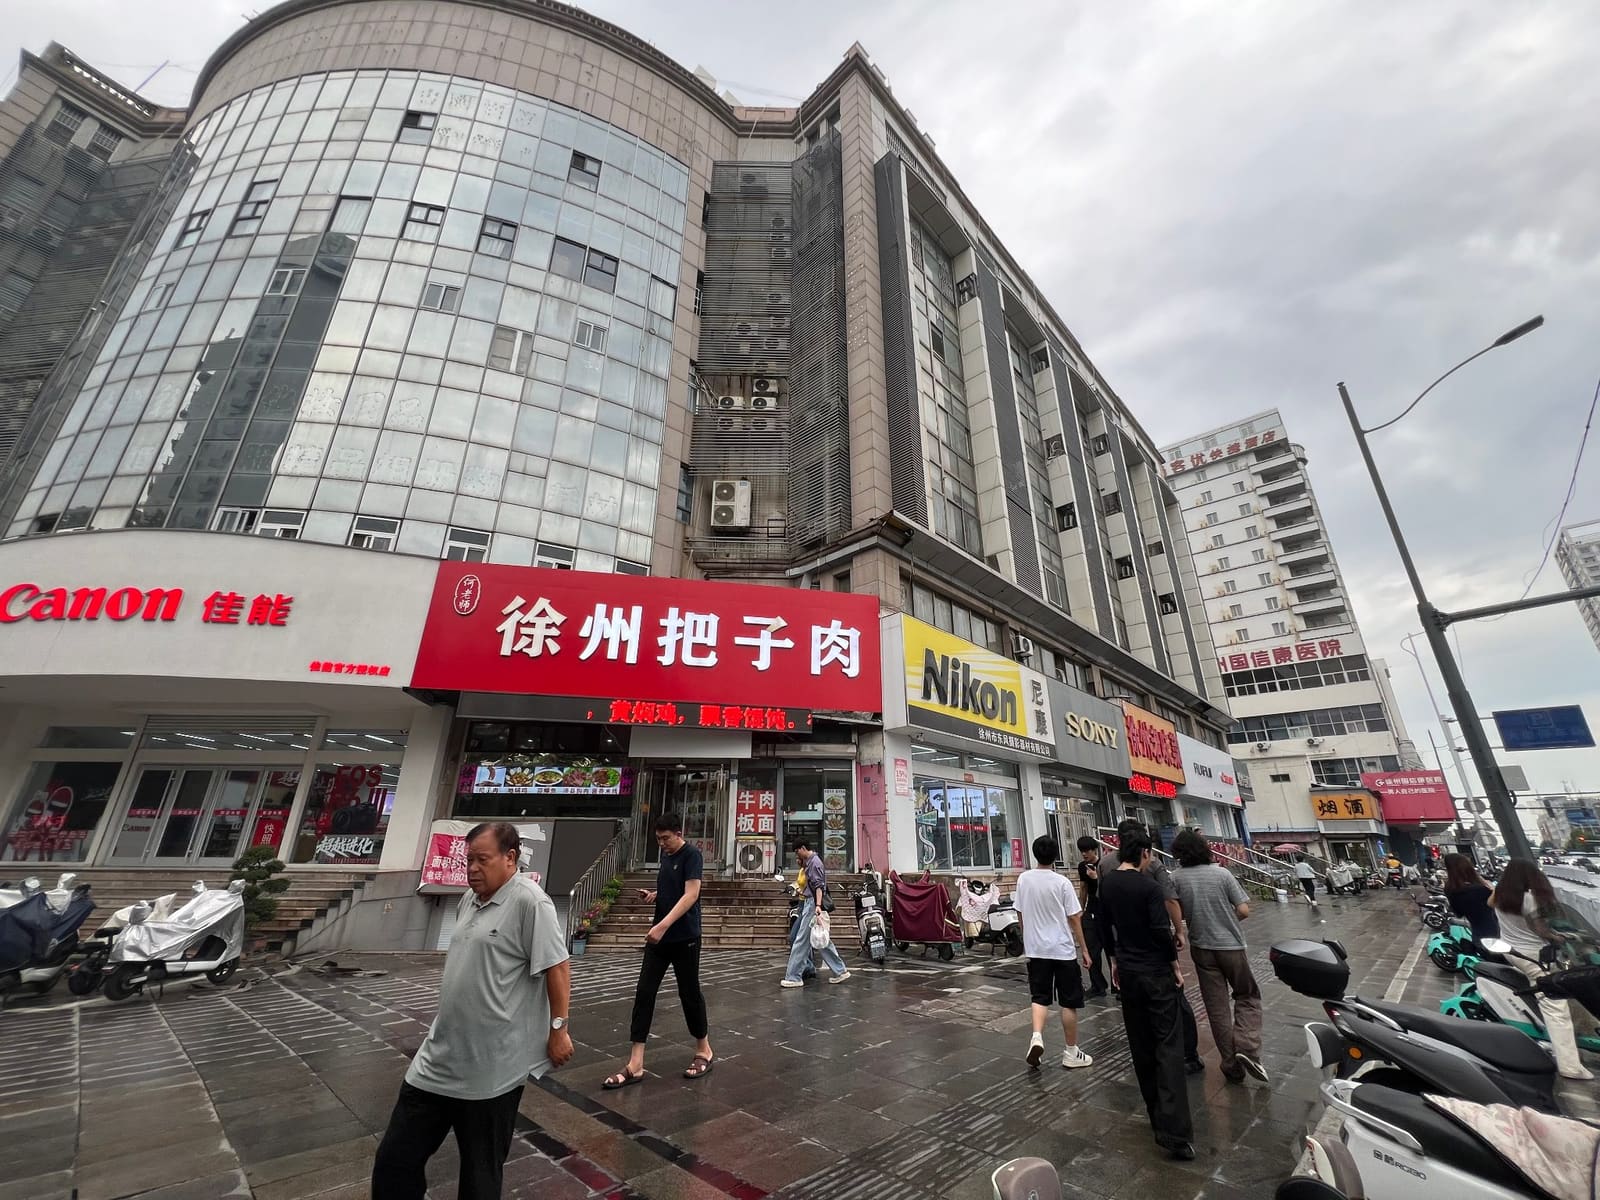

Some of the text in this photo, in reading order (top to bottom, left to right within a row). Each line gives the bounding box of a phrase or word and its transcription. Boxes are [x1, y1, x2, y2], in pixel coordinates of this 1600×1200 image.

[0, 583, 294, 626] Canon 佳能
[459, 578, 476, 611] 何老师
[496, 595, 862, 678] 徐州把子肉
[922, 648, 1017, 725] Nikon
[1065, 711, 1119, 749] SONY
[738, 790, 775, 810] 牛肉
[1318, 798, 1364, 816] 烟酒
[737, 813, 775, 833] 板面
